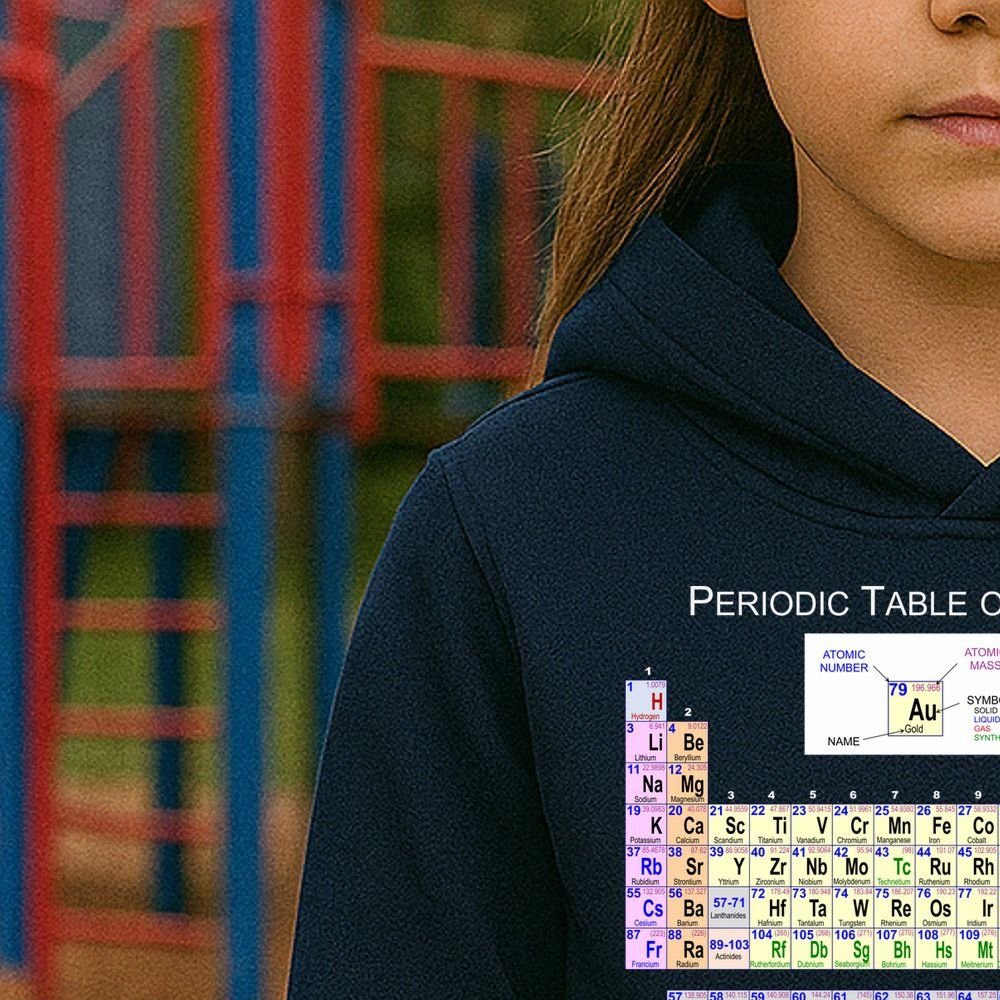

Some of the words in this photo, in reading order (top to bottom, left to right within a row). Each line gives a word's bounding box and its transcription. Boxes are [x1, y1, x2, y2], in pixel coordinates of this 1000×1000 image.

[823, 650, 865, 659] ATOMIC
[820, 663, 868, 672] NUMBER
[971, 661, 1000, 670] MASS
[644, 666, 651, 676] 1
[627, 682, 633, 691] 1
[889, 682, 908, 696] 79
[651, 692, 663, 711] H
[684, 707, 692, 717] 2
[909, 698, 936, 721] Au
[974, 706, 999, 715] SOLID
[631, 713, 660, 721] Hydrogen
[973, 715, 1000, 724] LIQUID
[627, 724, 634, 732] 3
[668, 724, 676, 733] 4
[904, 724, 924, 734] Gold
[649, 733, 663, 751] Li
[684, 733, 704, 752] Be
[828, 737, 860, 746] NAME
[673, 753, 702, 762] Beryllium
[727, 790, 735, 800] 3
[767, 790, 776, 800] 4
[809, 790, 817, 800] 5
[849, 790, 857, 800] 6
[891, 790, 899, 800] 7
[932, 790, 941, 800] 8
[974, 790, 982, 800] 9
[627, 806, 640, 815] 19
[709, 806, 722, 815] 21
[751, 806, 765, 815] 22
[651, 816, 663, 835] K
[725, 816, 746, 835] Sc
[772, 816, 787, 835] Ti
[750, 847, 765, 858] 40
[957, 847, 971, 856] 45
[769, 857, 787, 876] Zr
[973, 857, 994, 876] Rh
[755, 877, 786, 885] Zirconium
[963, 877, 991, 885] Rhodium
[626, 889, 640, 897] 55
[792, 888, 806, 898] 73
[917, 889, 930, 897] 76
[714, 898, 744, 907] 57-71
[643, 899, 664, 918] Cs
[808, 899, 827, 918] Ta
[930, 899, 952, 918] Os
[922, 918, 948, 926] Osmium
[793, 930, 813, 939] 105
[710, 940, 749, 949] 89-103
[810, 940, 828, 959] Db
[715, 952, 742, 960] Actinides
